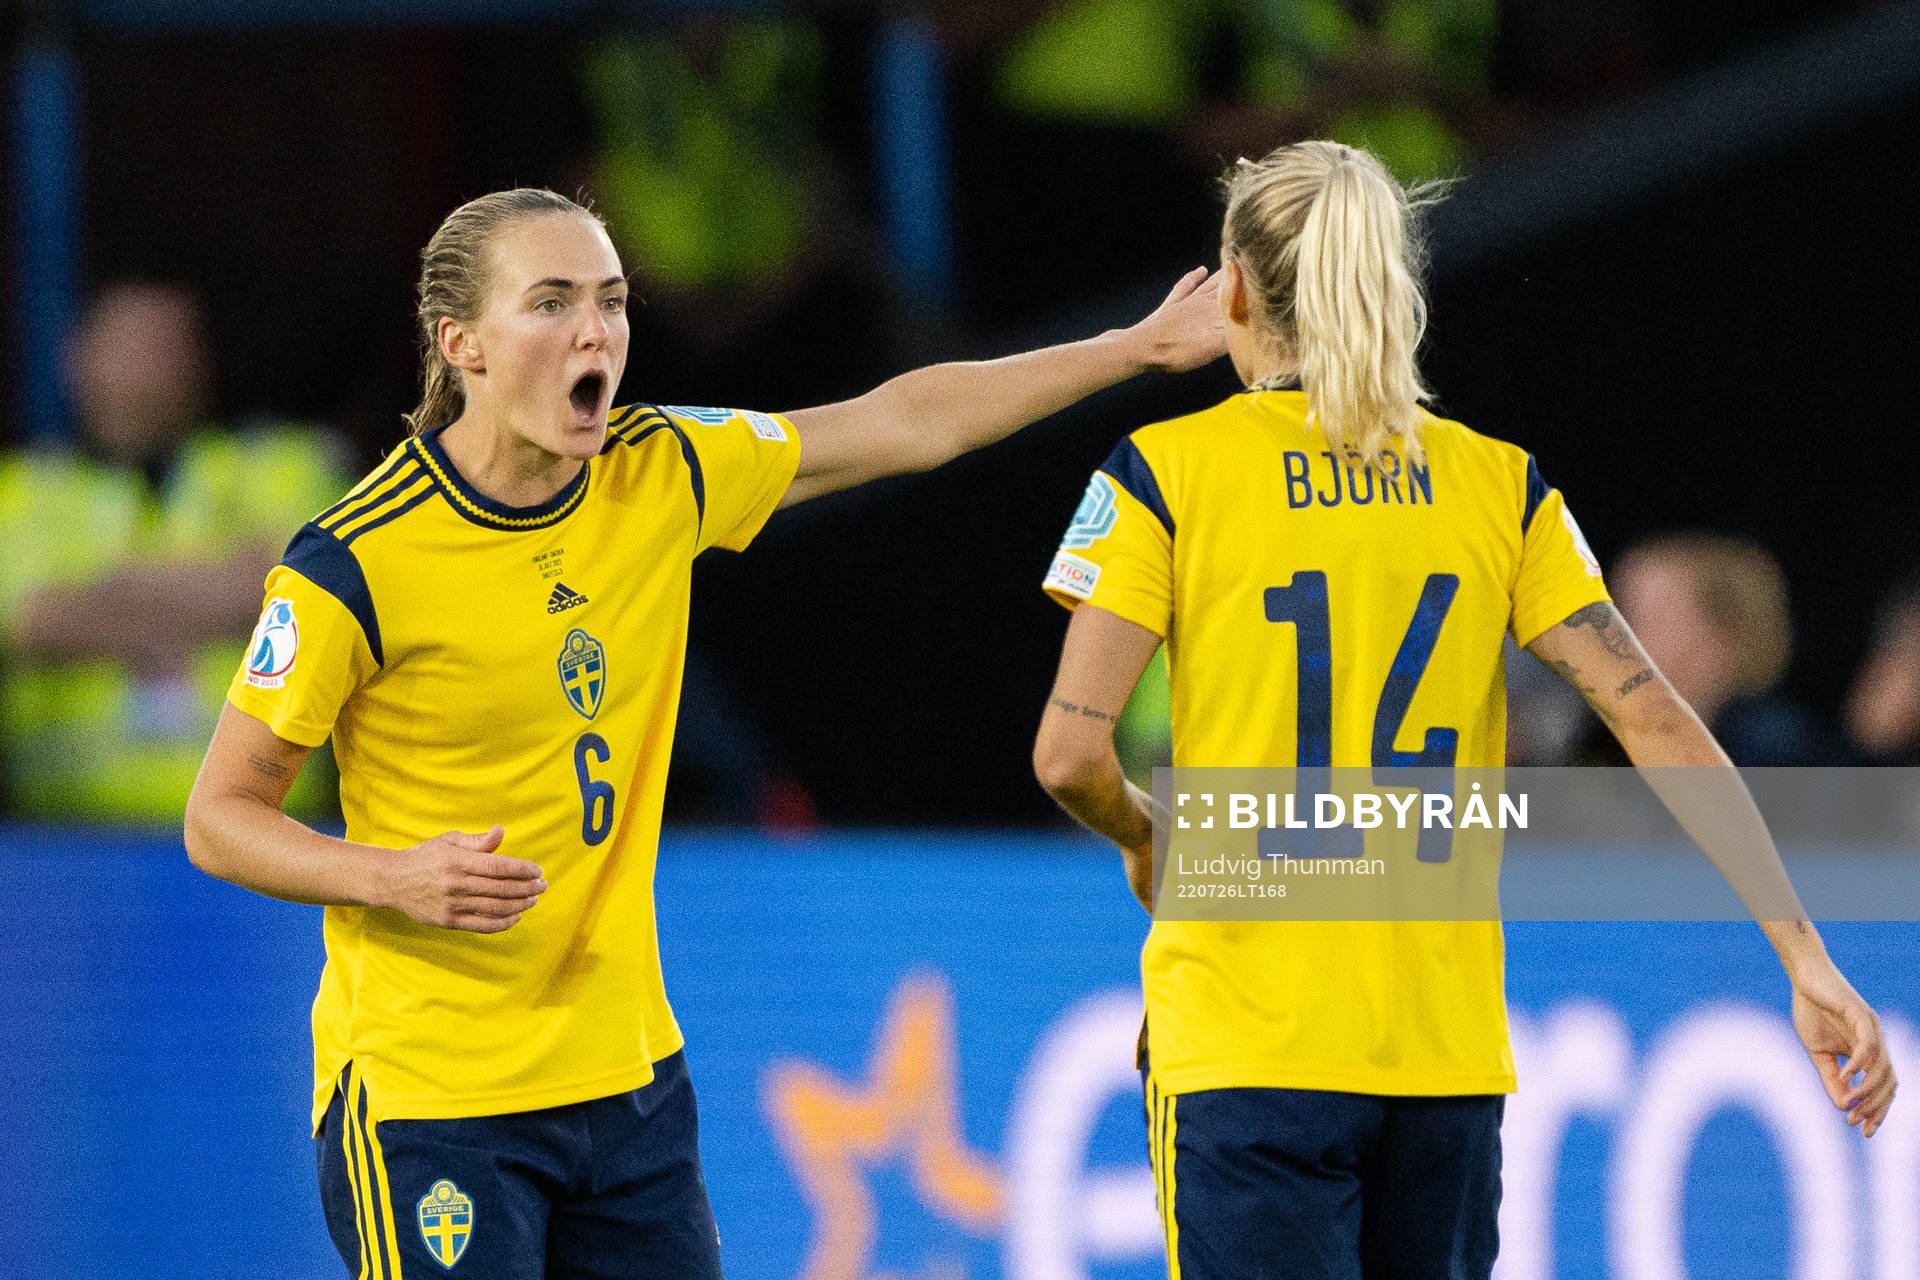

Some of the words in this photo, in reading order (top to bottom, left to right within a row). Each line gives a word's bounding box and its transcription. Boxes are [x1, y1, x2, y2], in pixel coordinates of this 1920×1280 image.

[547, 595, 589, 614] adidas
[1257, 570, 1460, 863] 14
[574, 732, 615, 847] 6
[427, 1205, 464, 1214] SVERIGE
